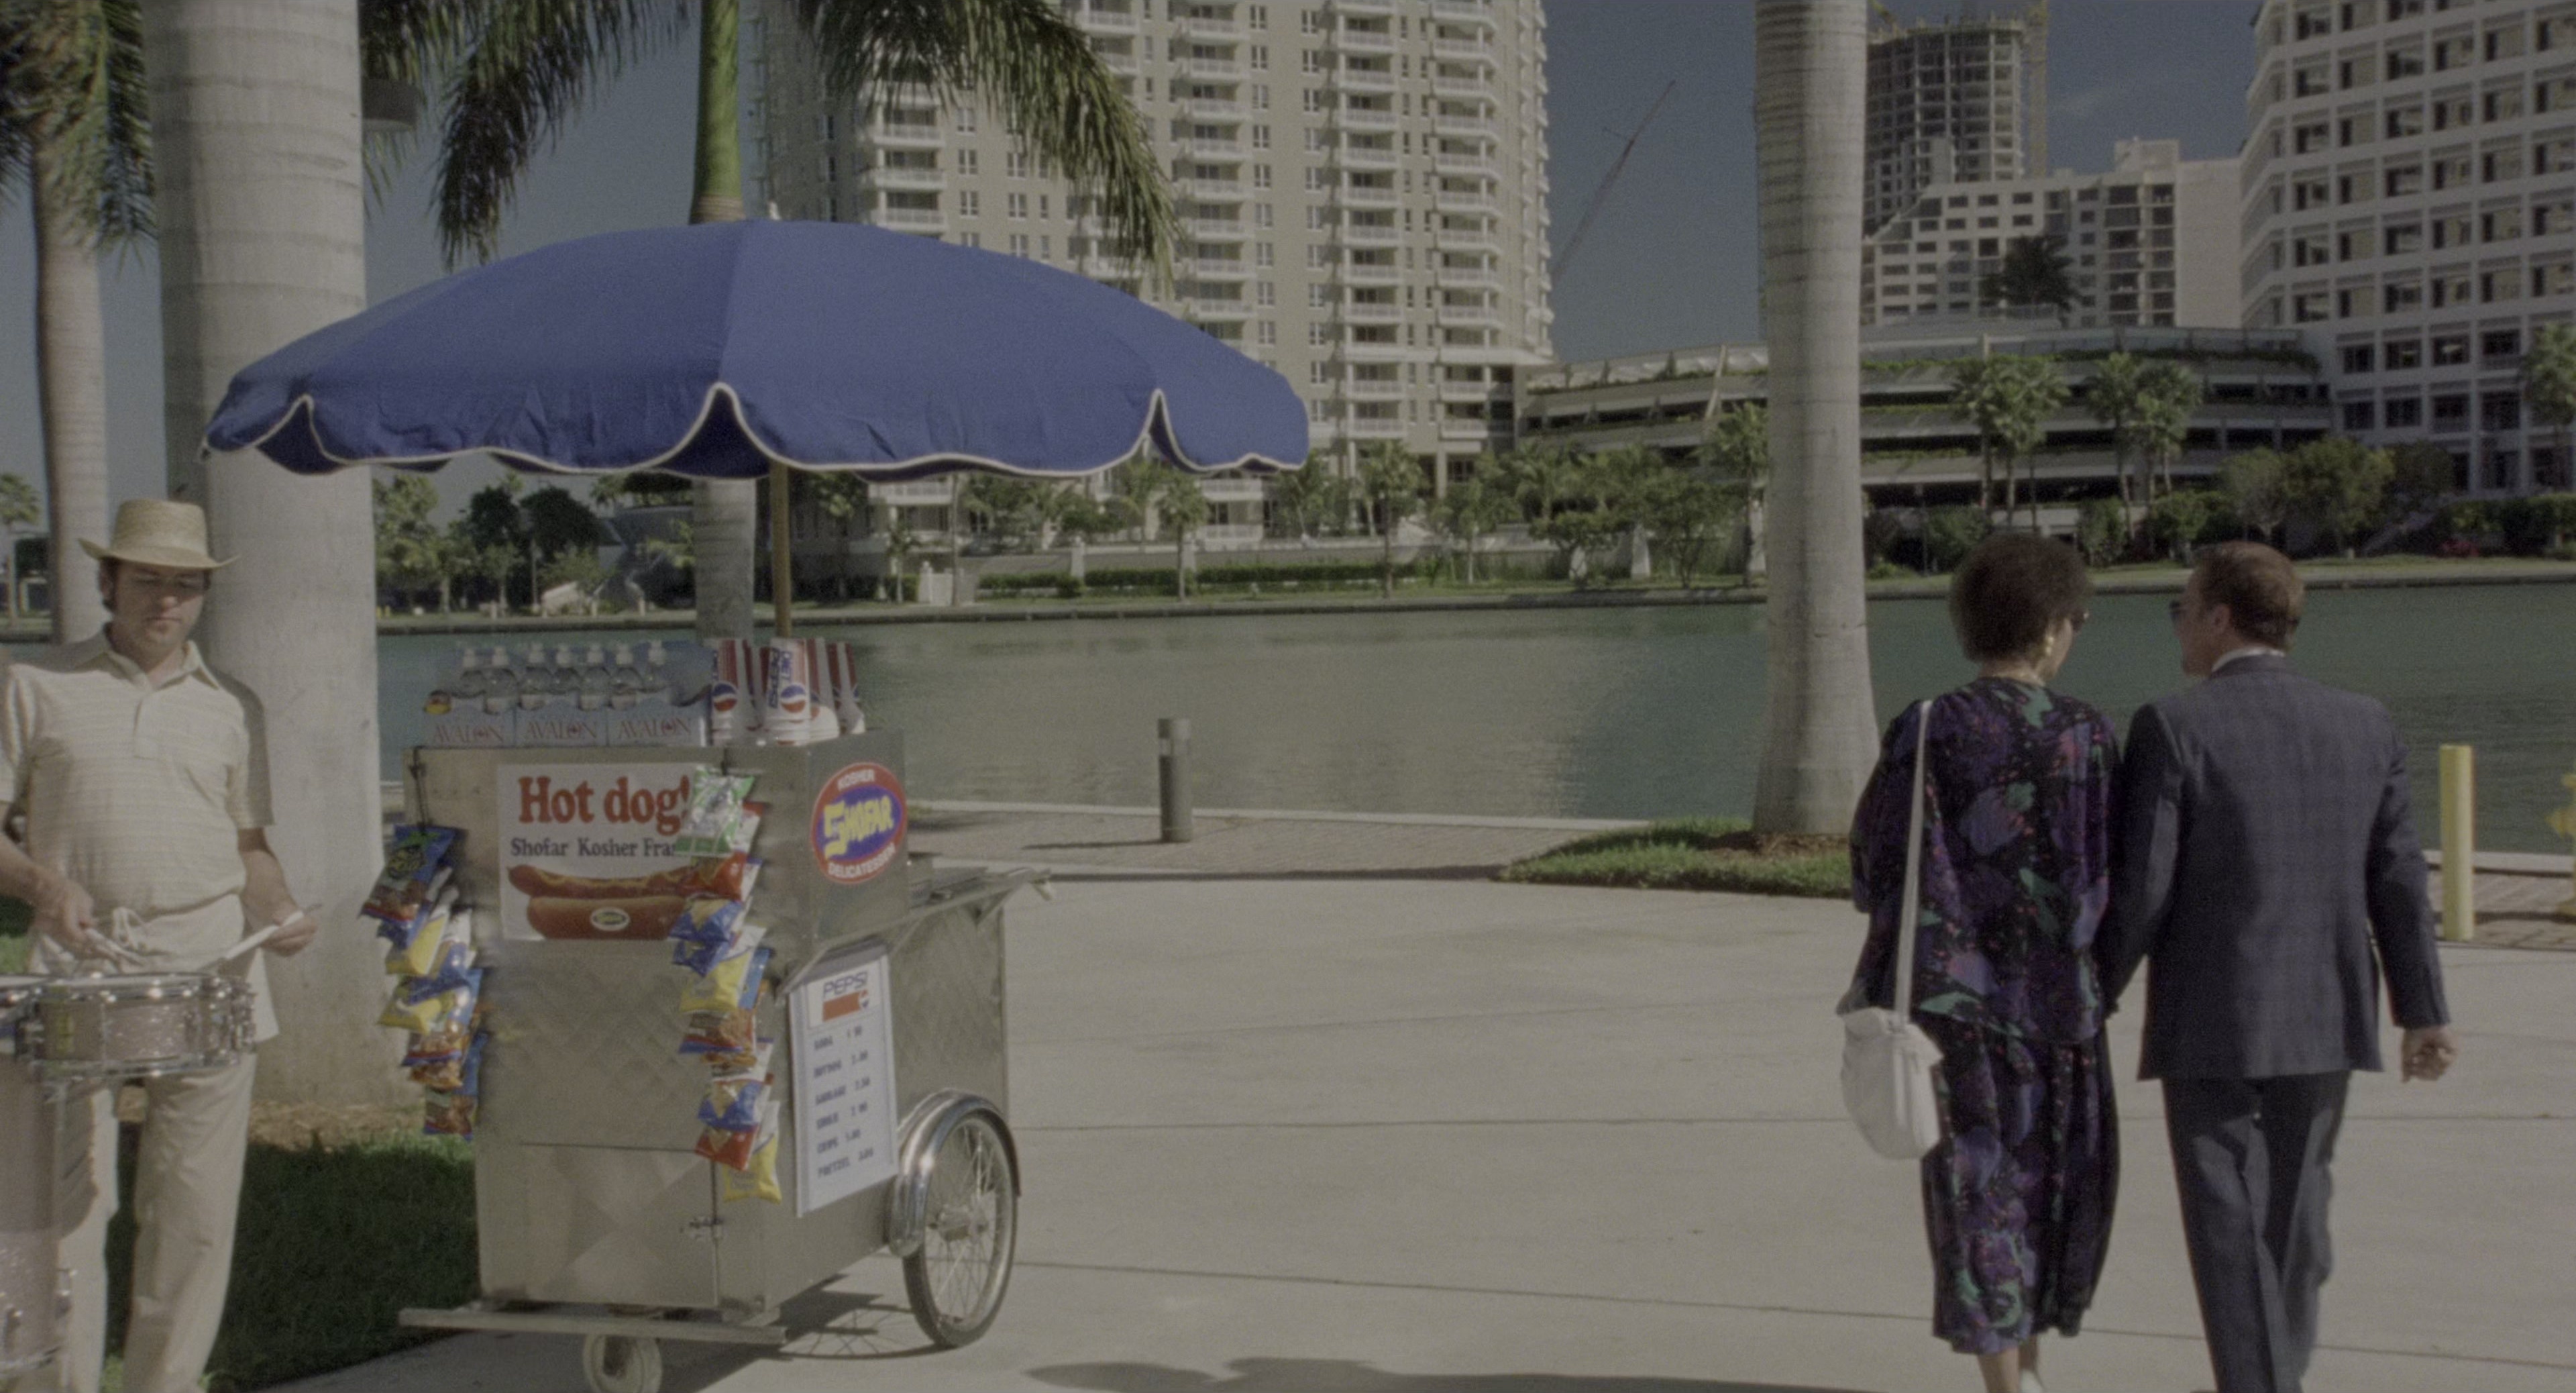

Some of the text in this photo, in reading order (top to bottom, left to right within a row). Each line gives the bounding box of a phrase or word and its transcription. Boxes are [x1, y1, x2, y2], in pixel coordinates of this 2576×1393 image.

[433, 724, 504, 743] AVALON
[526, 721, 598, 739] AVALON
[620, 717, 692, 738] AVALON
[837, 769, 875, 790] KOSHER
[518, 774, 690, 836] Hot dog!
[824, 795, 894, 860] SHOFAR
[511, 837, 568, 857] Shofar
[577, 838, 636, 857] Kosher
[828, 841, 896, 879] DELICATESSEN
[822, 971, 868, 1000] PEPSI
